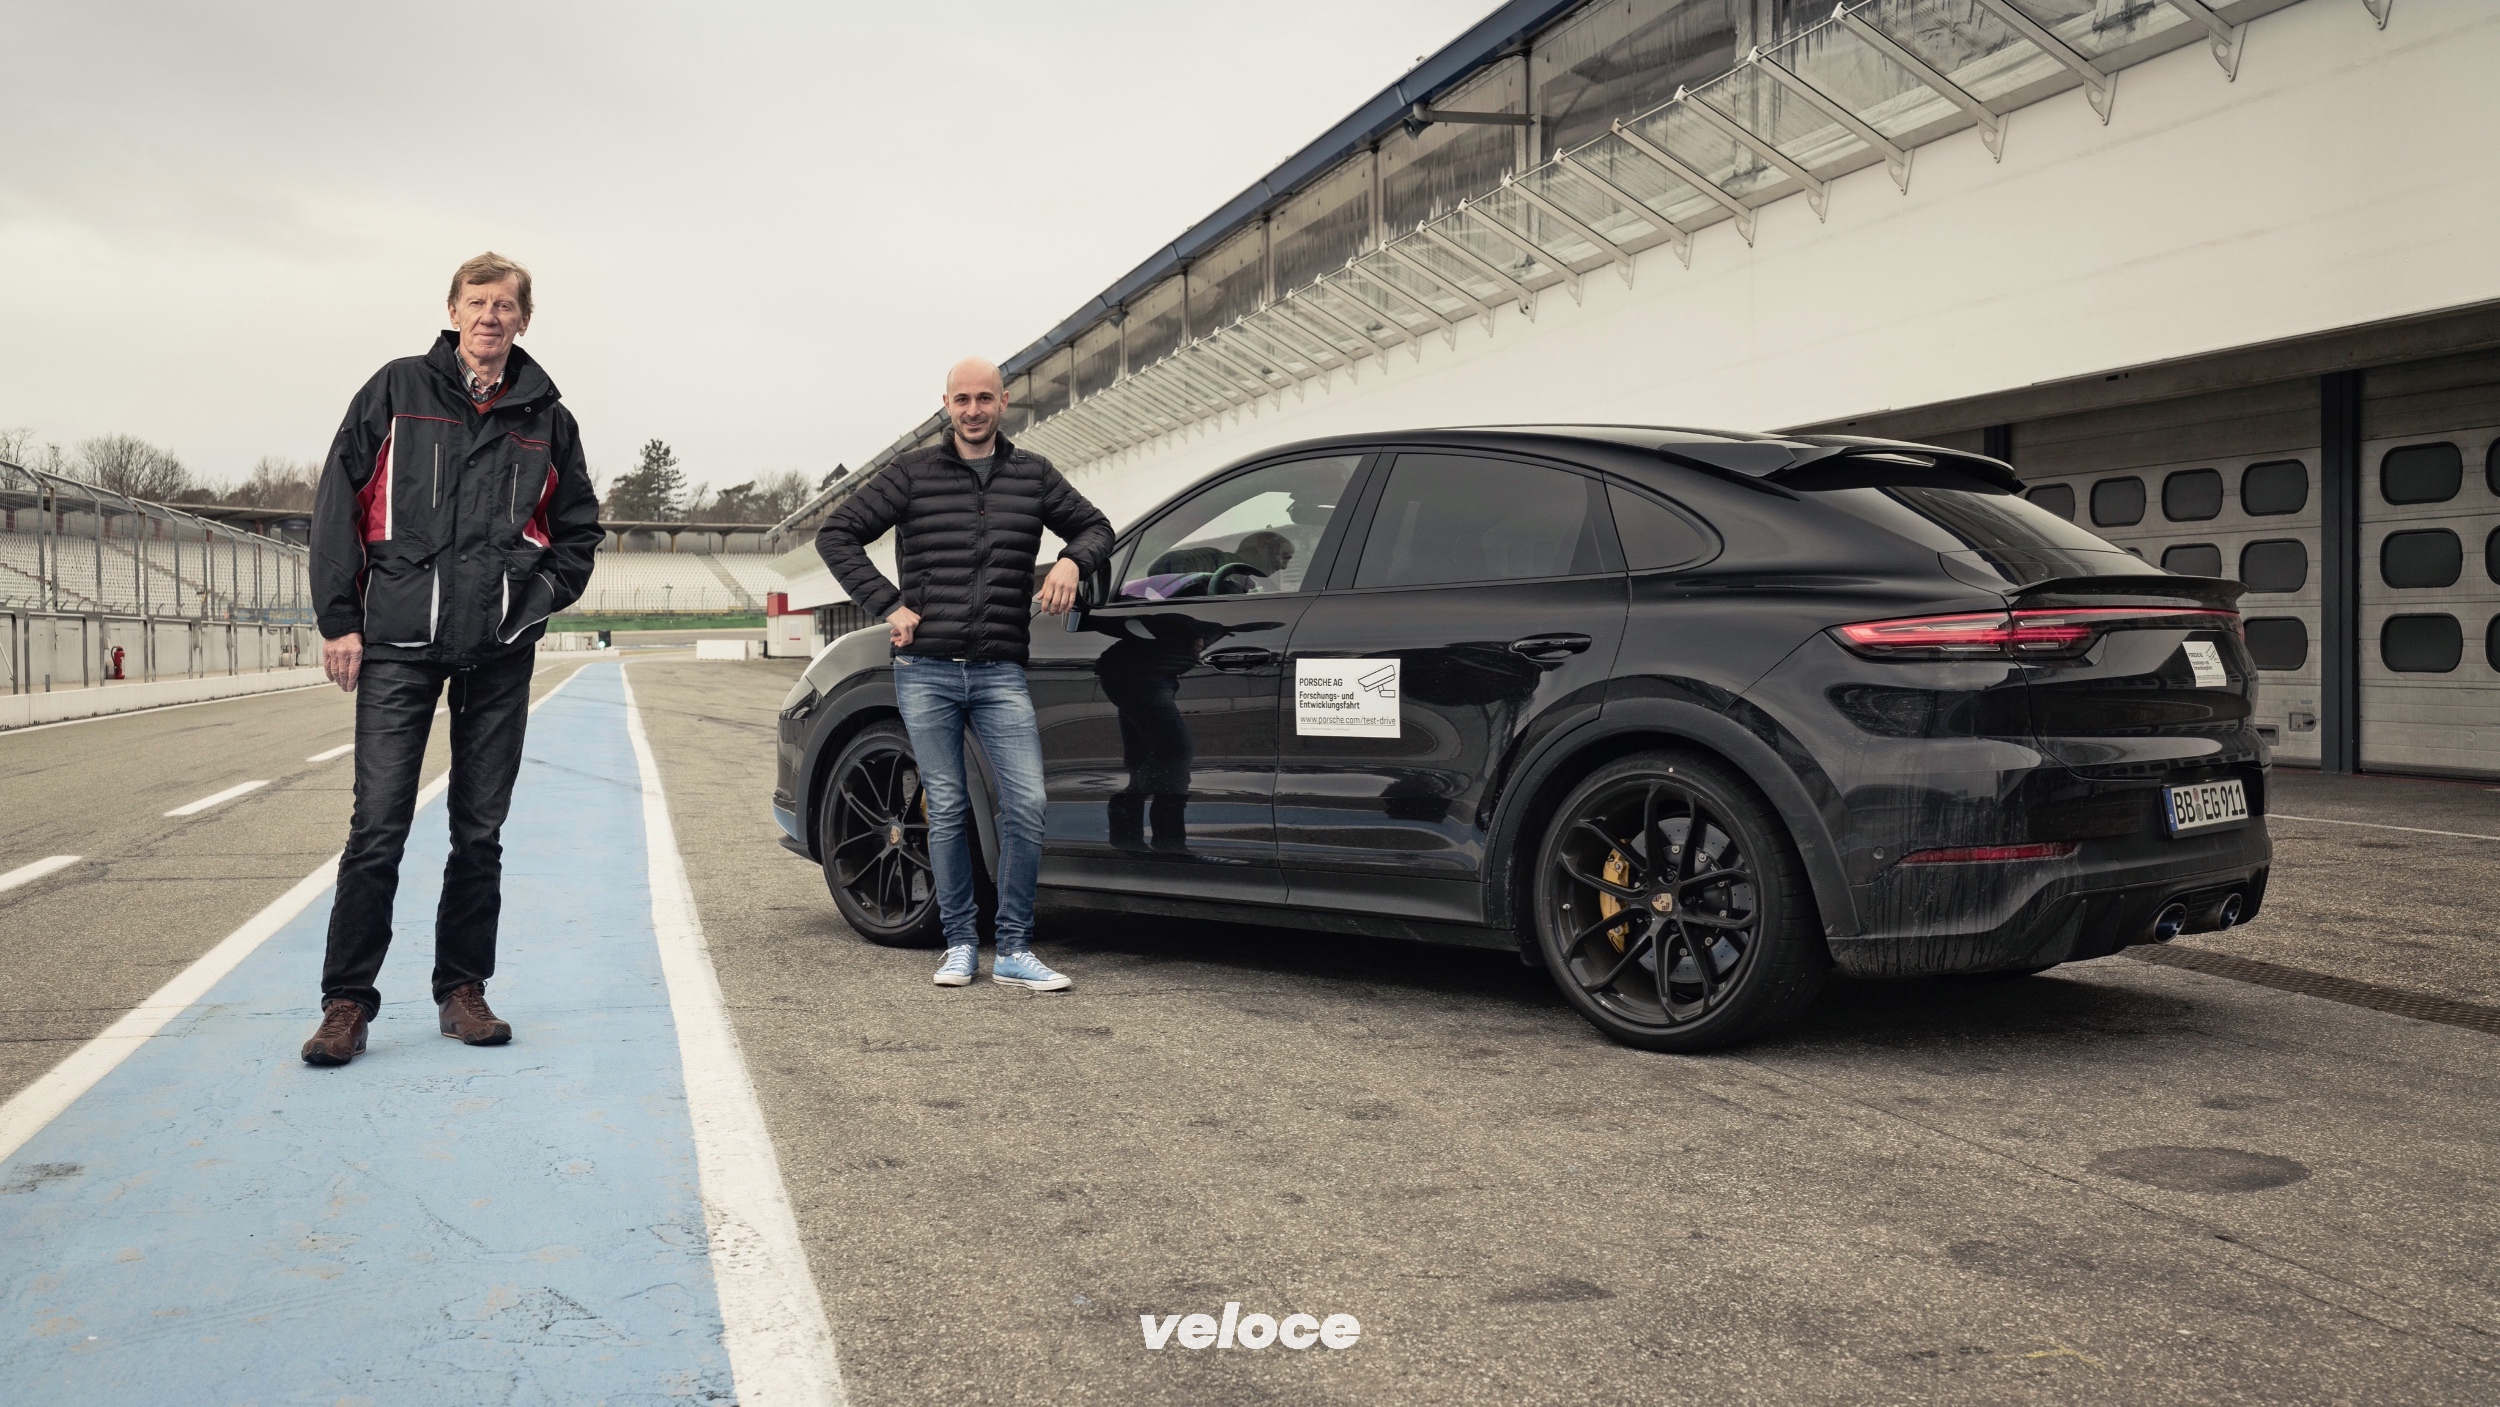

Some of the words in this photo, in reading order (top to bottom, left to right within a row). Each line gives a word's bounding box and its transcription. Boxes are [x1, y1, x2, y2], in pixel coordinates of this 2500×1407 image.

[1300, 678, 1332, 687] PORSCHE
[1333, 678, 1343, 687] AG
[1300, 691, 1340, 702] Forschungs-
[1341, 692, 1354, 700] und
[1300, 700, 1360, 711] Entwicklungsfahrt
[1300, 716, 1396, 725] www.porsche.com/test-drive
[2173, 791, 2196, 825] BB
[2201, 787, 2222, 820] EG
[2220, 784, 2246, 817] 911
